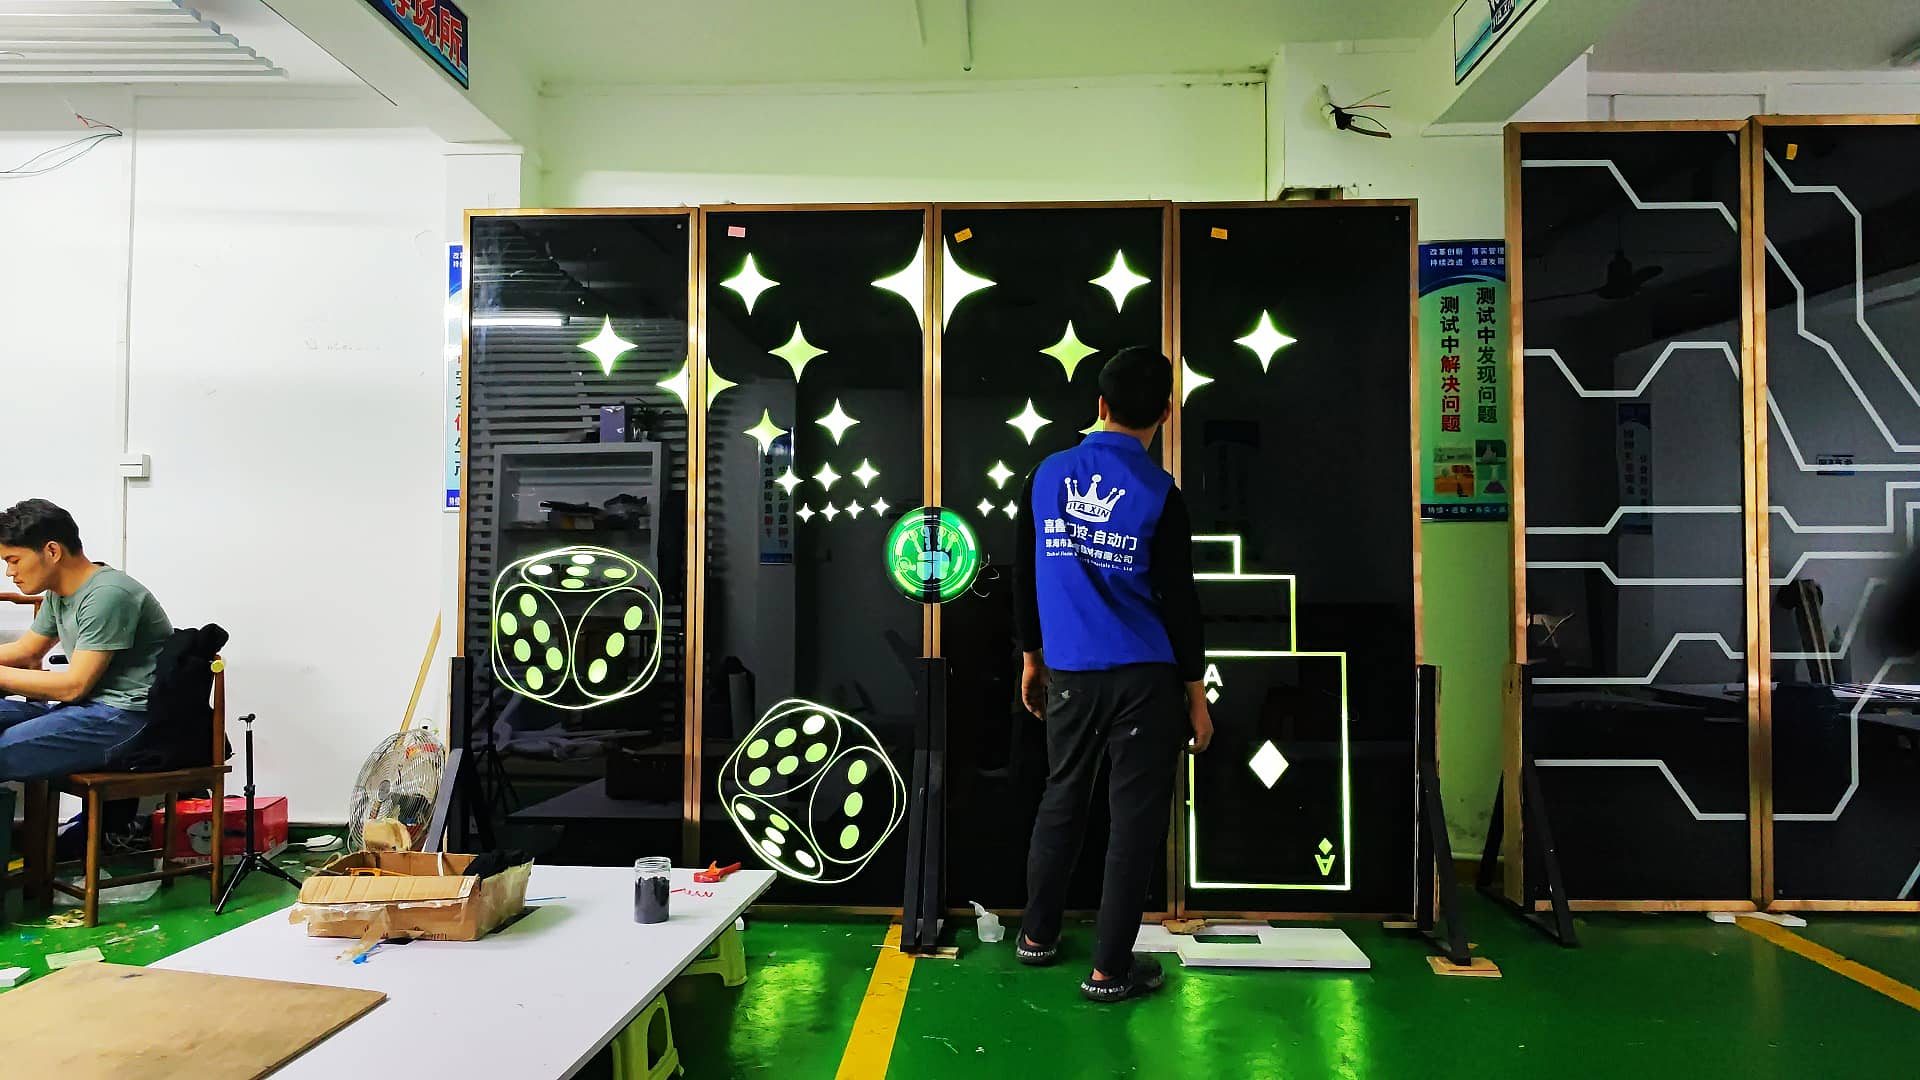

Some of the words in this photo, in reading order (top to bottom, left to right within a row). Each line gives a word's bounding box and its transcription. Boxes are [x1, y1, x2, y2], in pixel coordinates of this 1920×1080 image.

[1440, 295, 1461, 433] 测试中解决问题
[1475, 286, 1498, 424] 测试中发现问题
[1068, 501, 1086, 511] JIA
[1089, 506, 1109, 518] XIN
[1203, 663, 1224, 687] A
[1315, 854, 1336, 876] A
